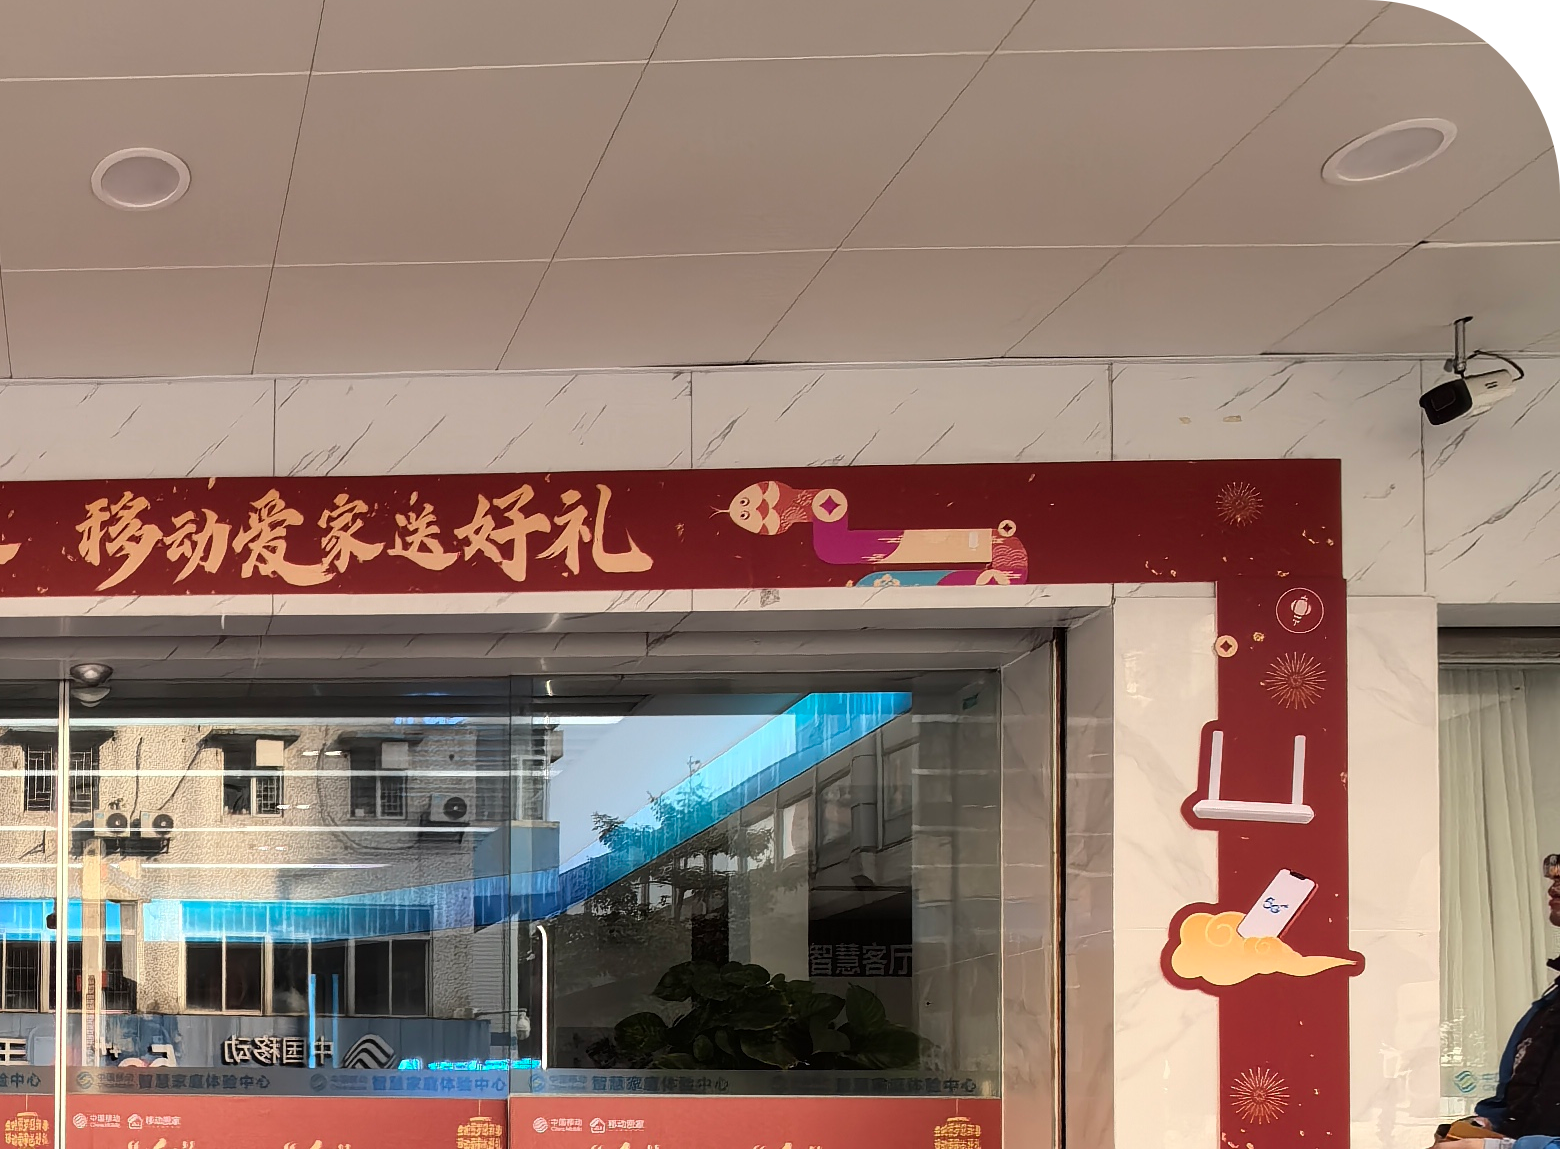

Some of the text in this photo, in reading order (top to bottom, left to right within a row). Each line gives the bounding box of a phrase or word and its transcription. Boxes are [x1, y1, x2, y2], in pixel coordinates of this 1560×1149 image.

[75, 484, 654, 590] 移动爱家送好礼
[809, 943, 913, 976] 智慧客厅
[138, 1073, 270, 1089] 智慧家庭体验中心
[372, 1075, 506, 1092] 智慧家庭体验中心
